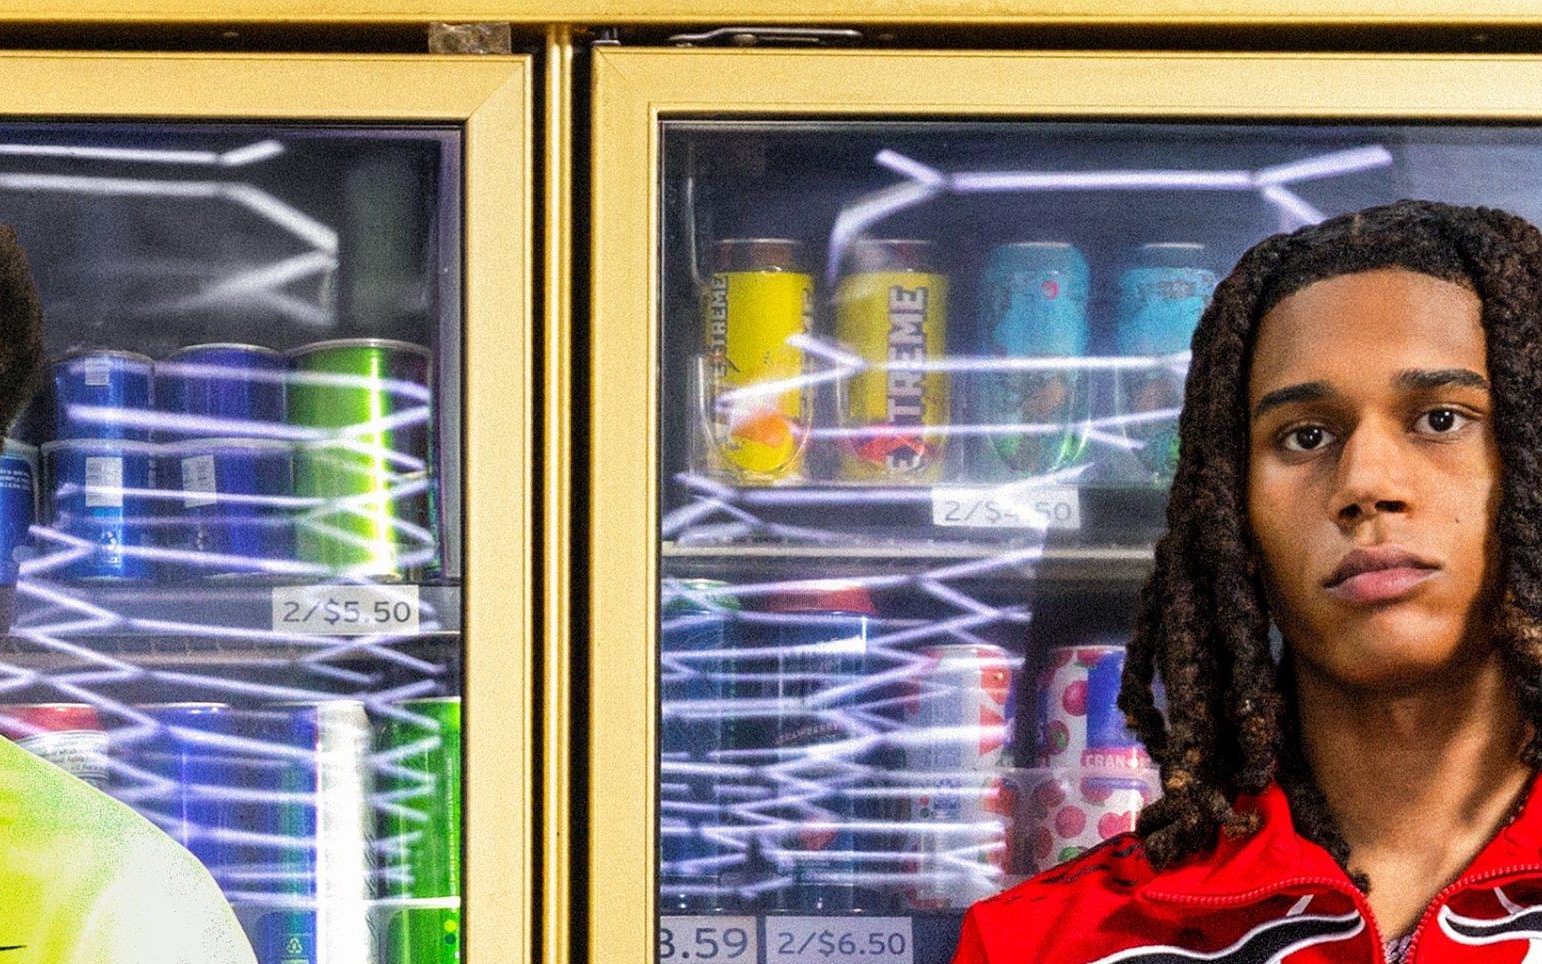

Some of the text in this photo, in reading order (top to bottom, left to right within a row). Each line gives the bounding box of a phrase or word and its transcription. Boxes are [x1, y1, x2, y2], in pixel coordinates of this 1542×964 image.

[943, 499, 1073, 526] 2/$50
[282, 600, 412, 628] 2/$5.50
[776, 929, 907, 959] 2/$6.50
